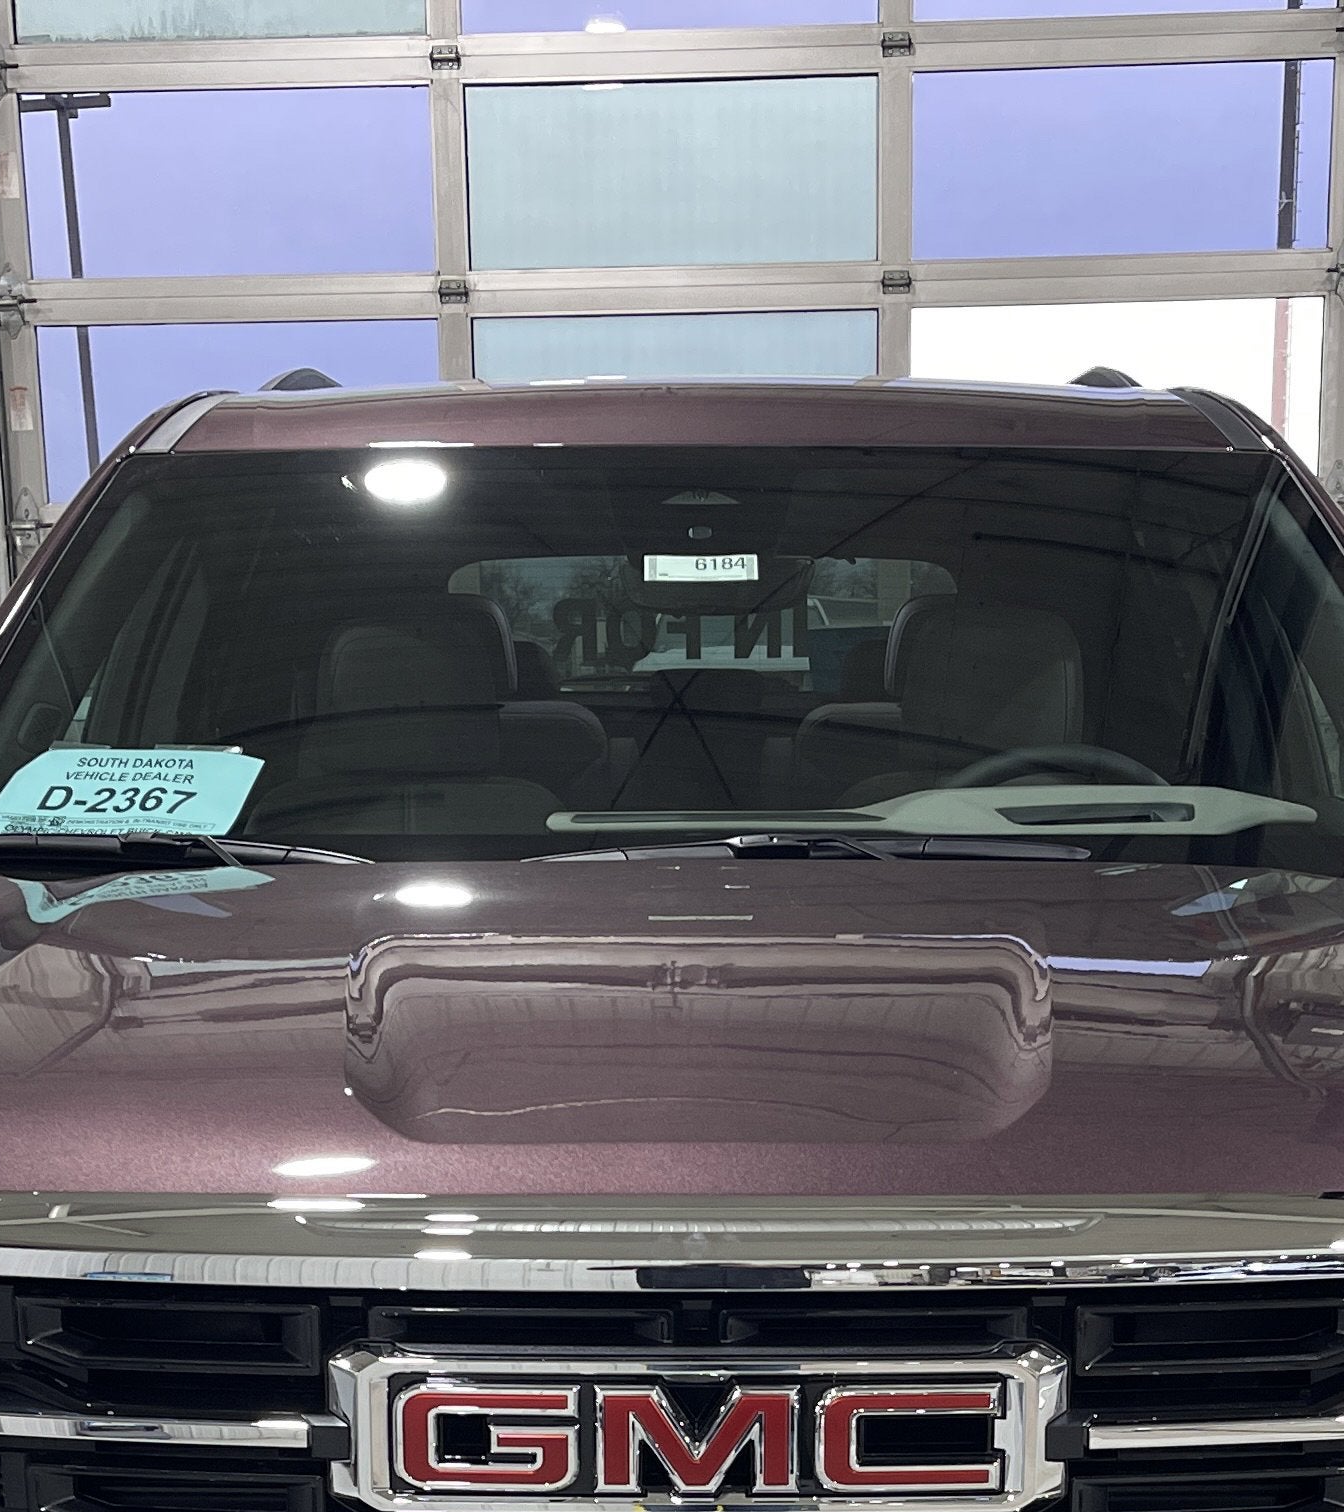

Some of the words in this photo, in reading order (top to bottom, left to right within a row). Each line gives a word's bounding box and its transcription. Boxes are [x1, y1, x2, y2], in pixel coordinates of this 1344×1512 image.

[695, 556, 746, 571] 6184
[76, 756, 128, 768] SOUTH
[132, 757, 195, 770] DAKOTA
[65, 770, 130, 782] VEHICLE
[131, 771, 195, 785] DEALER
[36, 785, 198, 814] D-2367
[393, 1383, 1002, 1494] GMC
